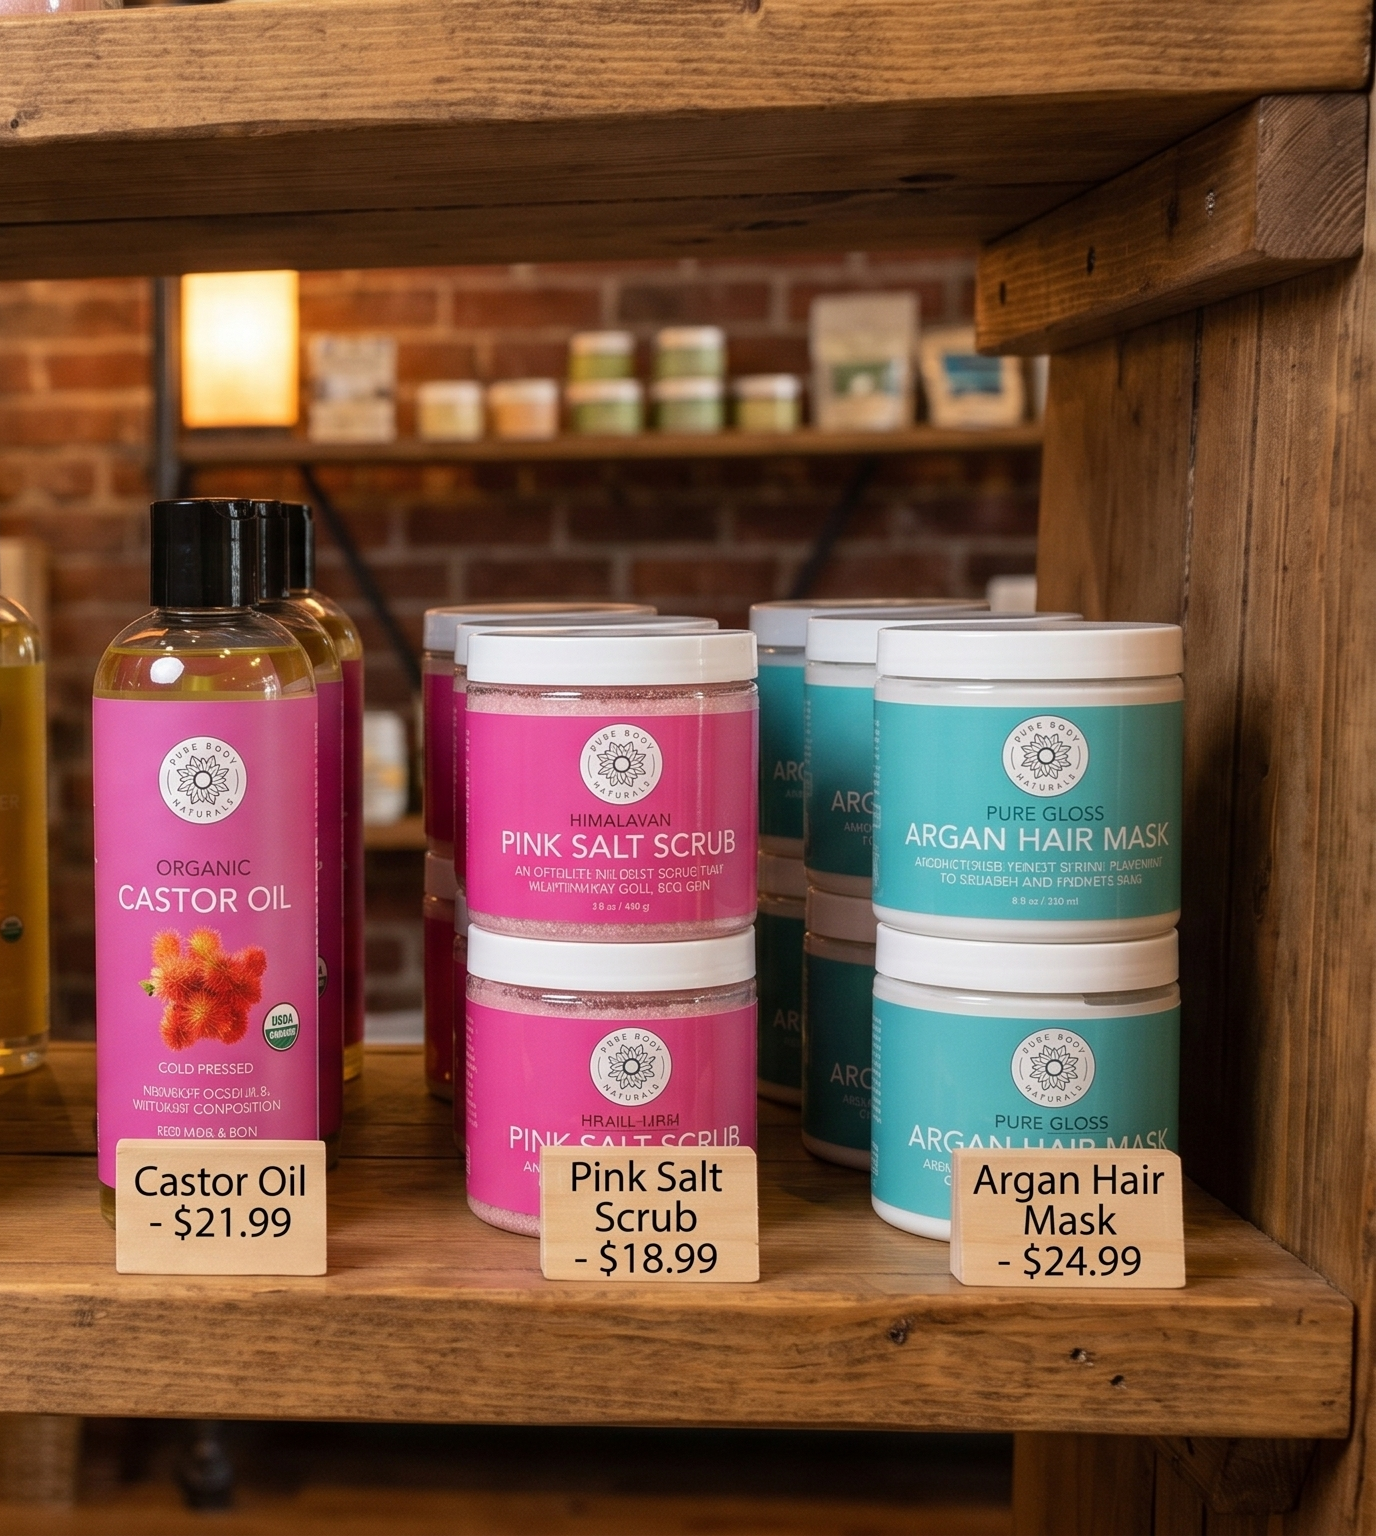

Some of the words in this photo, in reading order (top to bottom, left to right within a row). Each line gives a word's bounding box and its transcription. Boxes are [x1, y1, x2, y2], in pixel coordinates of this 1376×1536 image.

[987, 805, 1036, 821] PURE
[1042, 805, 1105, 822] GLOSS
[501, 830, 563, 858] PINK
[572, 833, 644, 859] SALT
[653, 829, 736, 858] SCRUB
[905, 822, 1006, 851] ARGAN
[1019, 827, 1093, 851] HAIR
[1104, 822, 1169, 850] MASK
[156, 859, 251, 877] ORGANIC
[514, 865, 531, 877] AN
[940, 872, 956, 884] TO
[1022, 876, 1053, 888] AND
[118, 884, 238, 913] CASTOR
[247, 884, 292, 912] OIL
[158, 1061, 195, 1075] COLD
[197, 1062, 254, 1075] PRESSED
[229, 1126, 258, 1138] BON
[995, 1114, 1043, 1130] PURE
[1050, 1115, 1109, 1131] GLOSS
[509, 1125, 571, 1153] PINK
[908, 1124, 1011, 1153] ARGAN
[134, 1165, 248, 1197] Castor
[258, 1164, 306, 1197] Oil
[572, 1159, 648, 1192] Pink
[657, 1159, 723, 1193] Salt
[973, 1164, 1080, 1203] Argan
[1093, 1163, 1165, 1195] Hair
[174, 1204, 291, 1241] $21.99
[595, 1200, 697, 1233] Scrub
[1024, 1203, 1117, 1236] Mask
[599, 1239, 717, 1277] $18.99
[1023, 1242, 1141, 1280] $24.99
